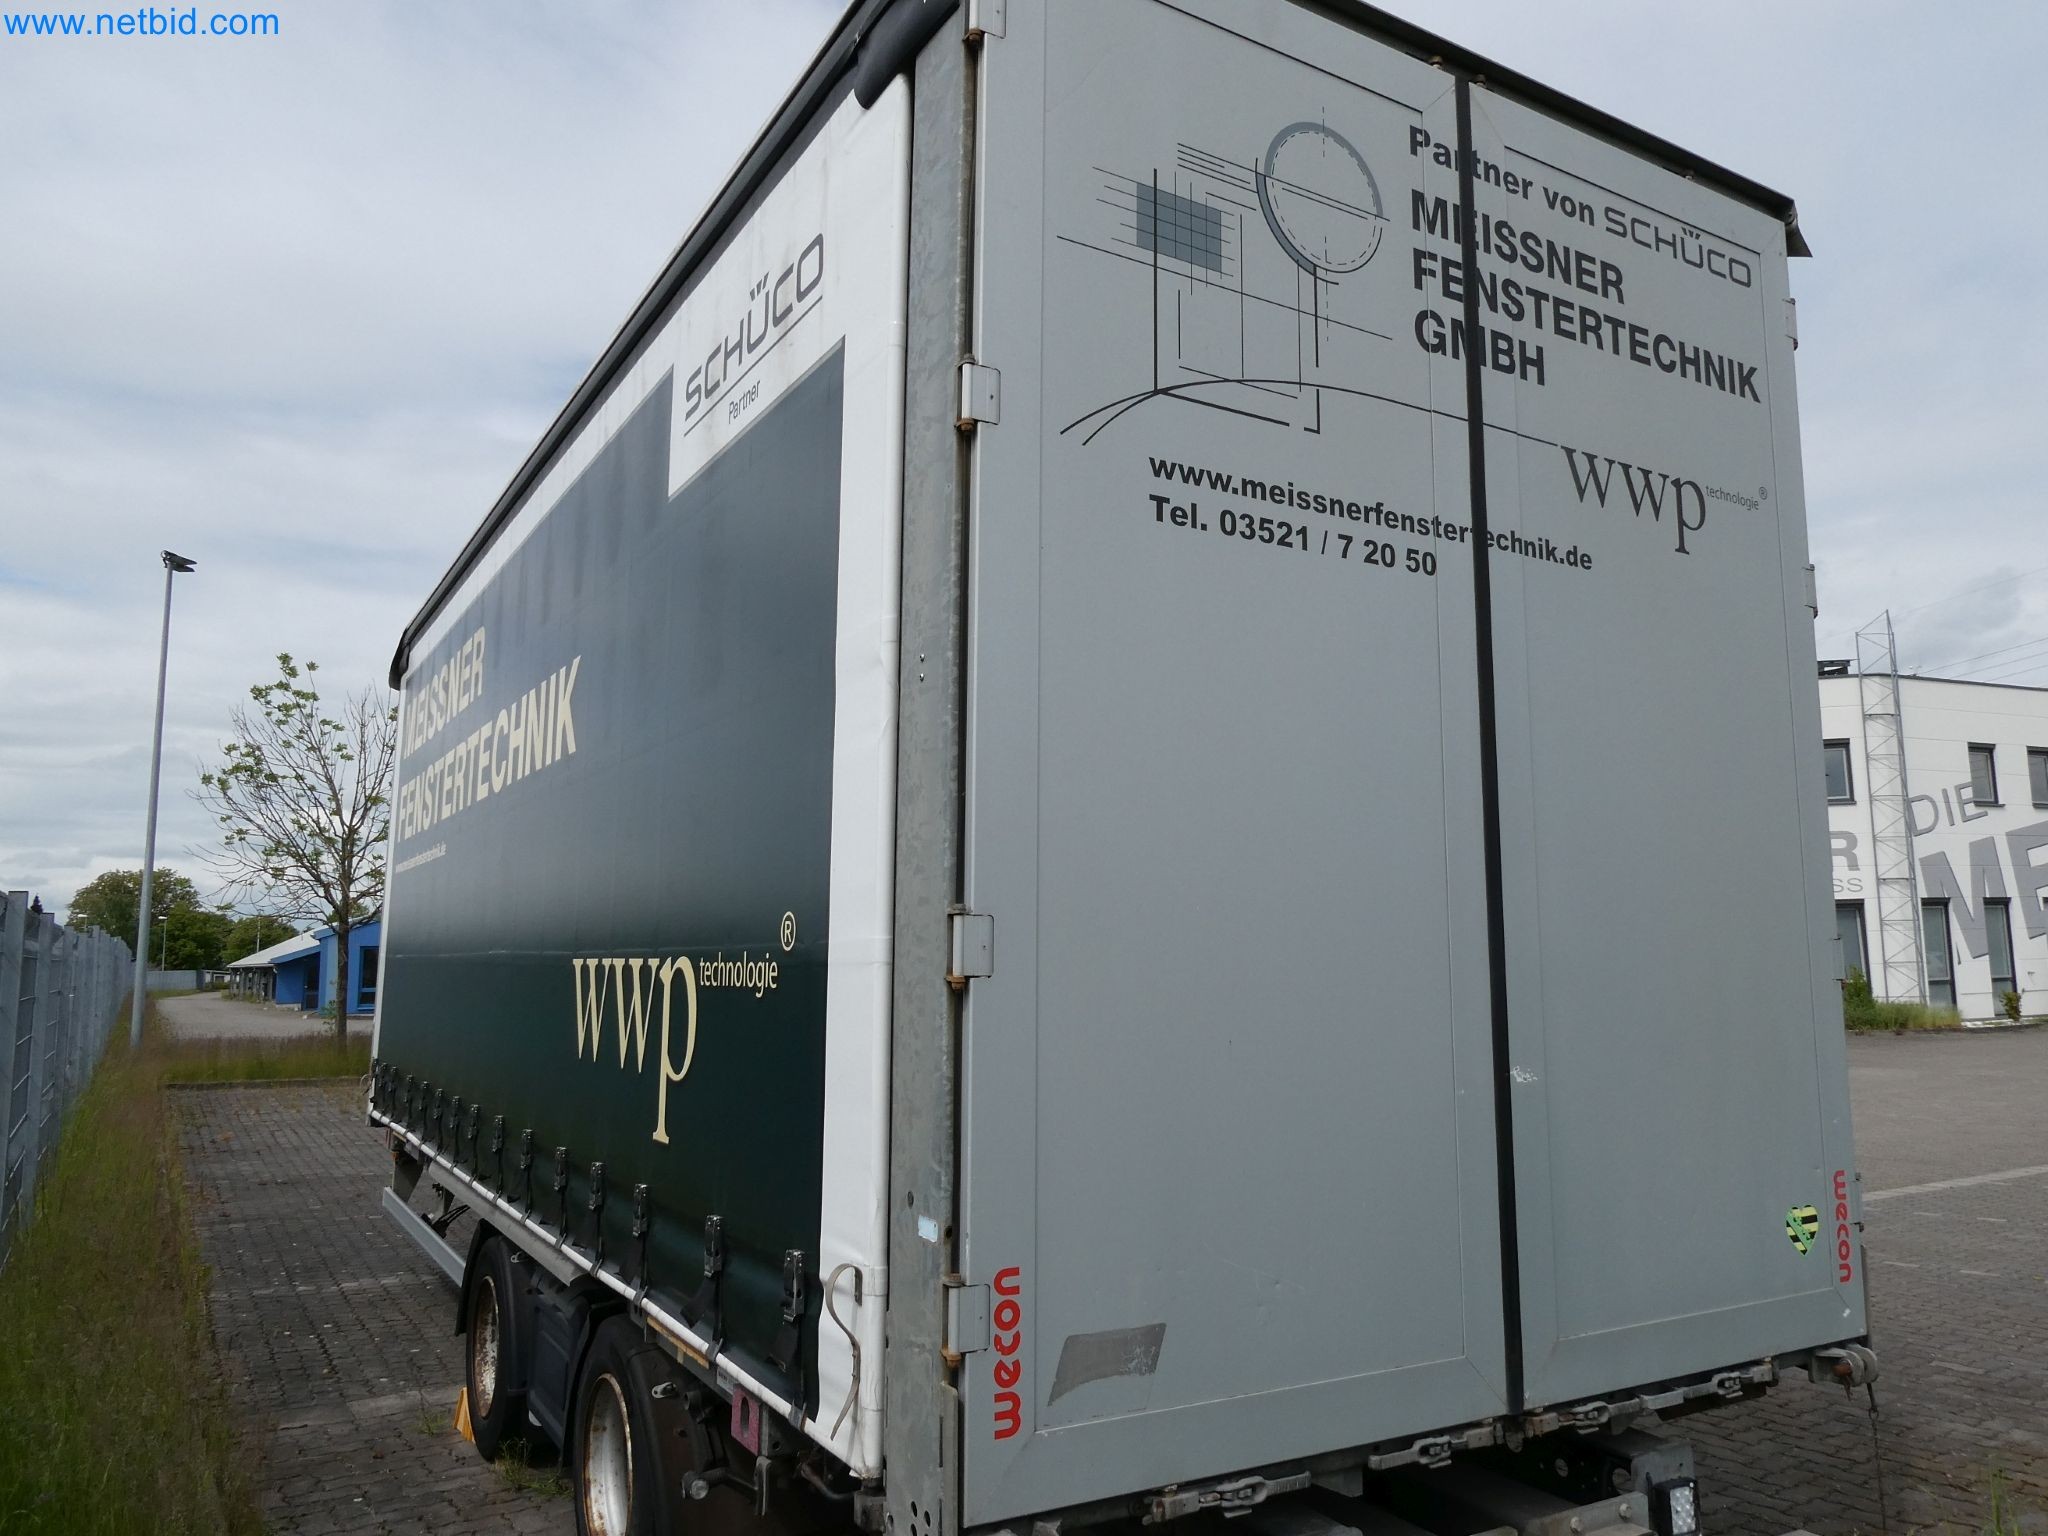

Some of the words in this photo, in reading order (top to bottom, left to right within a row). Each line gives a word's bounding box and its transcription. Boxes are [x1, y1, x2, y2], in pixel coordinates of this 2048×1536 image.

[1543, 186, 1595, 226] von
[1604, 205, 1751, 288] SCHÜCO
[685, 233, 824, 421] SCHÜCO
[1413, 247, 1760, 403] FENSTERTECHNIK
[1414, 309, 1545, 386] GMBH
[729, 380, 761, 424] Partner
[1149, 457, 1592, 570] www.meissnerfensterechnik.de
[1149, 494, 1208, 531] Tel.
[1219, 509, 1308, 551] 03521
[1337, 533, 1353, 559] 7
[1363, 539, 1396, 568] 20
[1405, 548, 1436, 576] 50
[1560, 445, 1706, 555] wwp
[1705, 485, 1759, 511] technologie
[398, 655, 582, 843] FENSTERTECHNIK
[403, 626, 486, 760] MEISSNER
[1907, 782, 1988, 837] DIE
[572, 955, 697, 1144] wwp
[700, 951, 778, 997] technologie
[1833, 1169, 1851, 1283] wecon
[994, 1267, 1021, 1440] wecon
